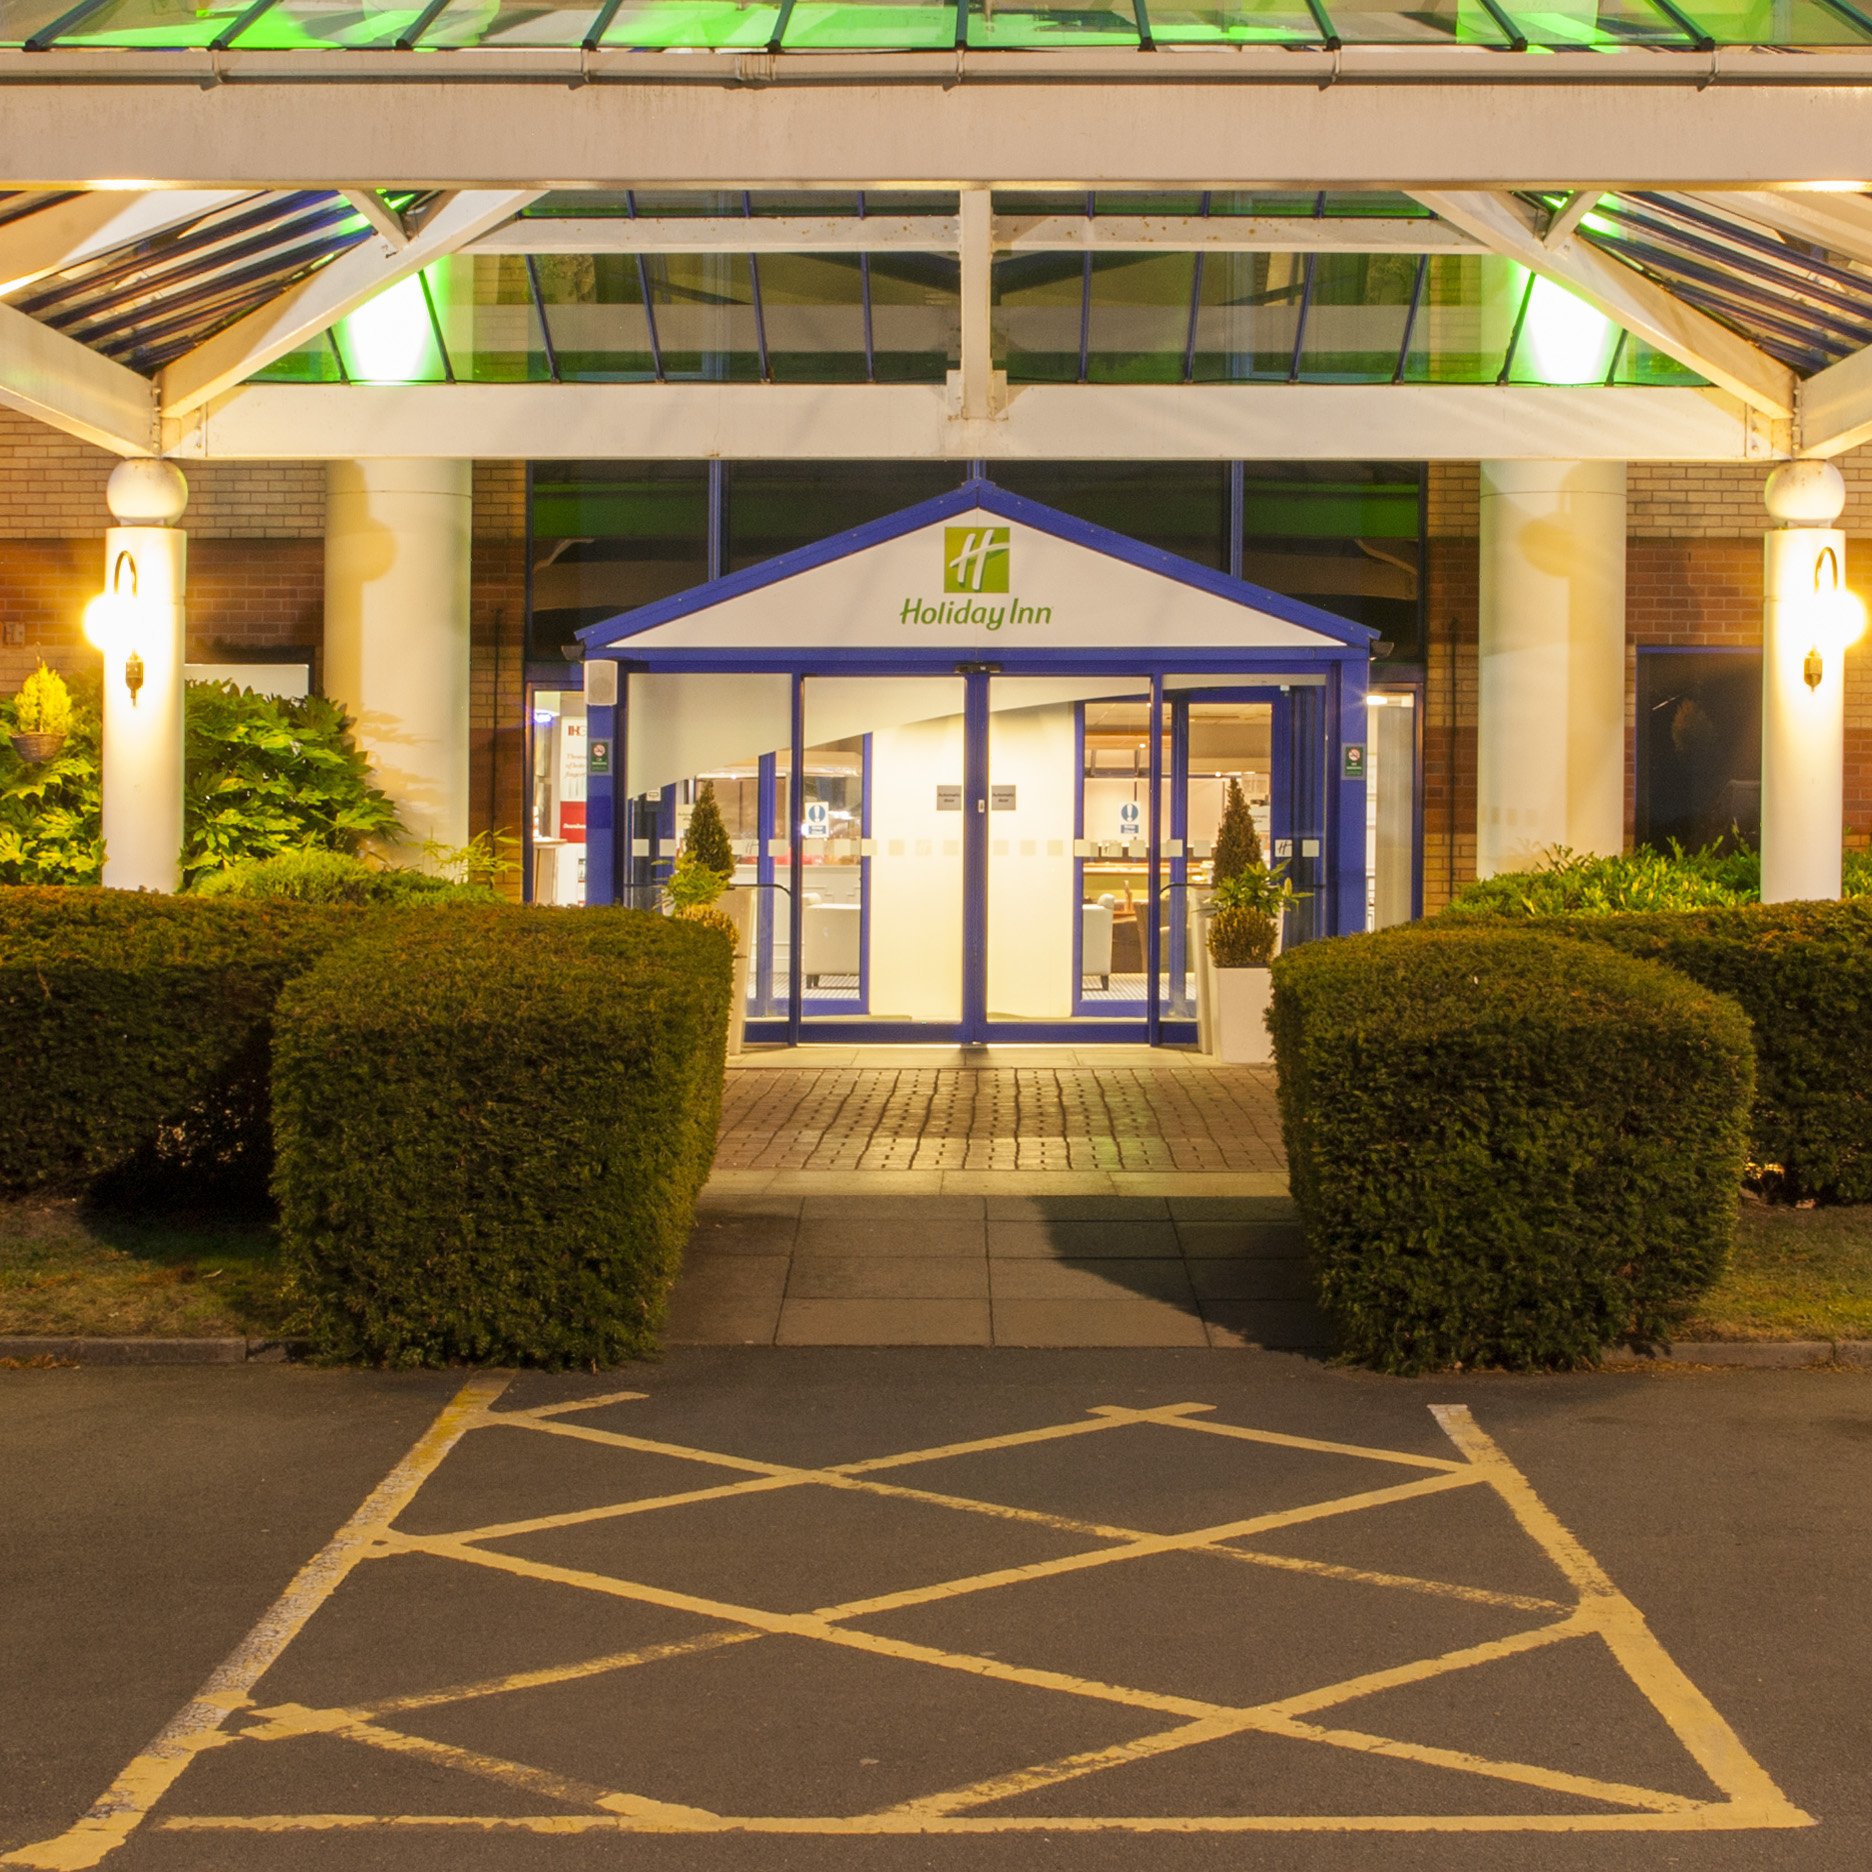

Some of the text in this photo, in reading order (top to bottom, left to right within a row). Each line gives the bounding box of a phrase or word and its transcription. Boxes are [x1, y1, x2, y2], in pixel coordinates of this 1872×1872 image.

[949, 529, 1010, 591] H
[899, 597, 1052, 631] Holiday Inn
